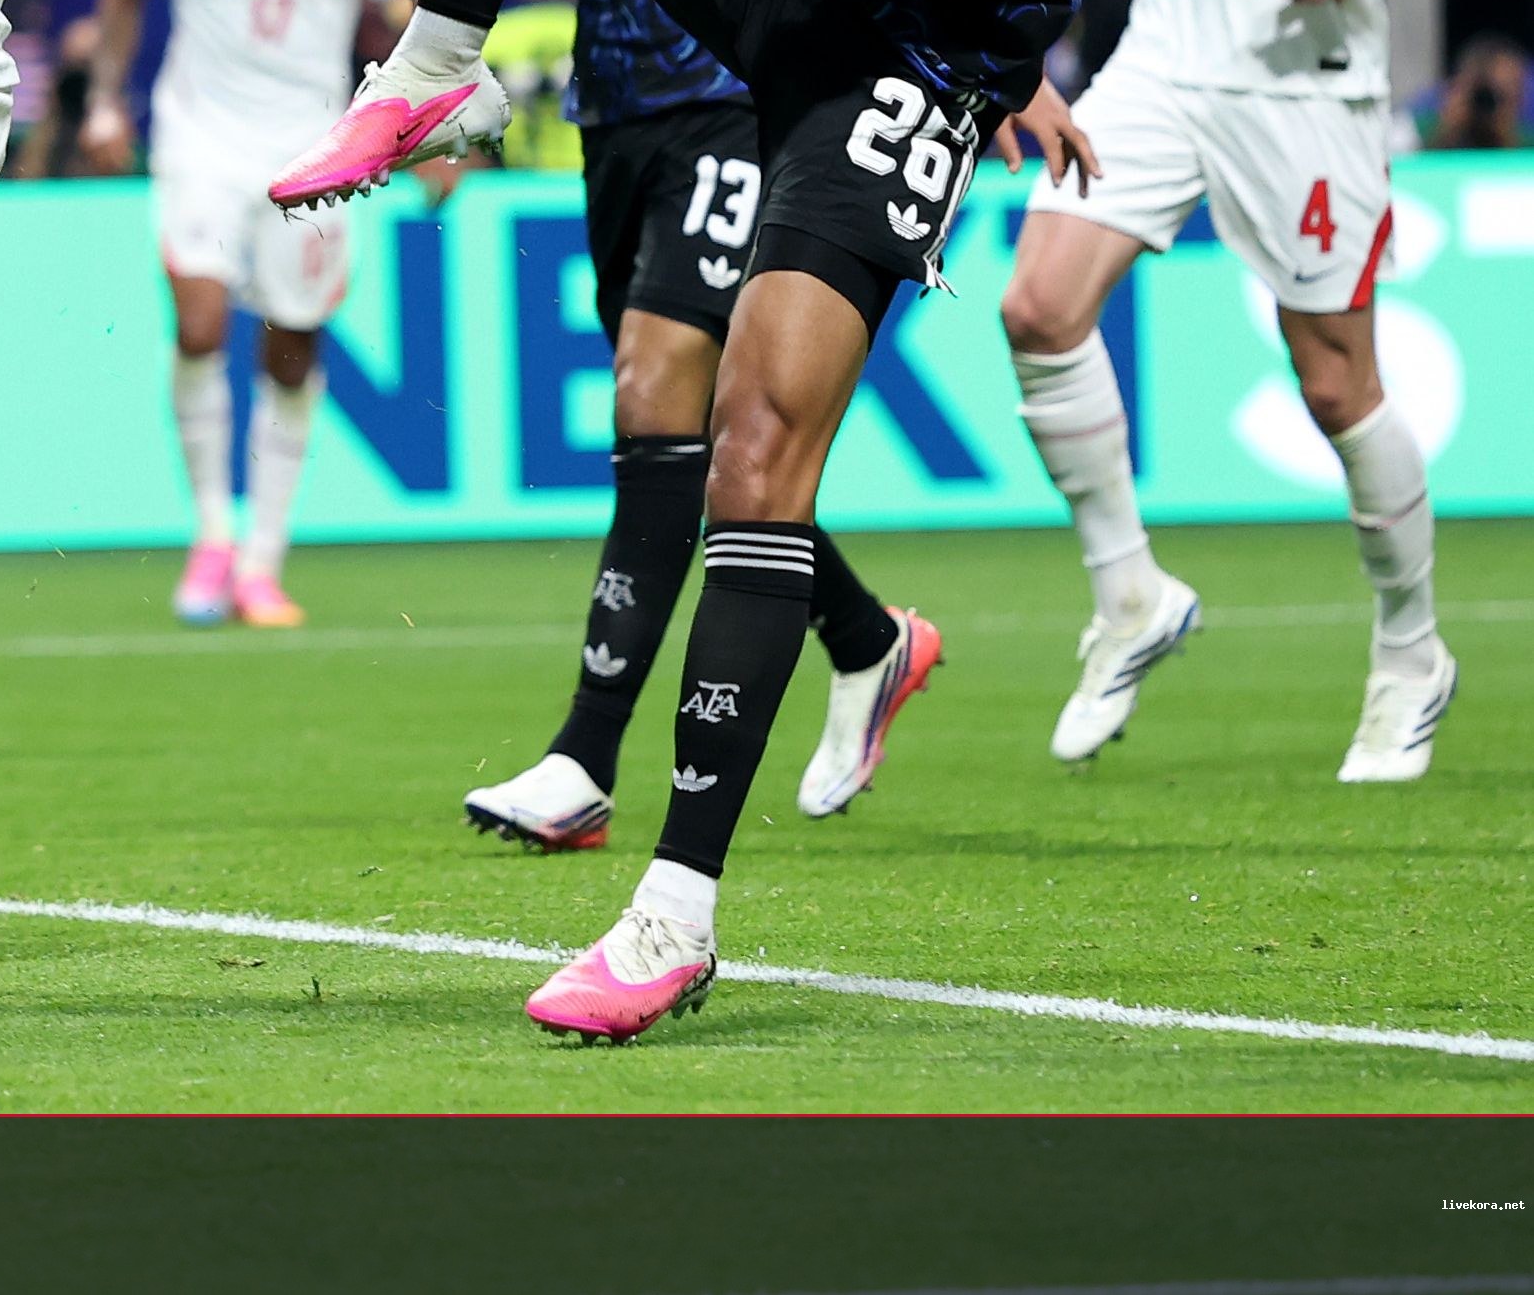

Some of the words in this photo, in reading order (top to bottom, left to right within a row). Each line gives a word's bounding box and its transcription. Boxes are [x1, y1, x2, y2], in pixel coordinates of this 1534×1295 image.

[846, 76, 954, 203] 26
[682, 153, 761, 249] 13
[1300, 177, 1338, 254] 4
[680, 679, 741, 724] AFA
